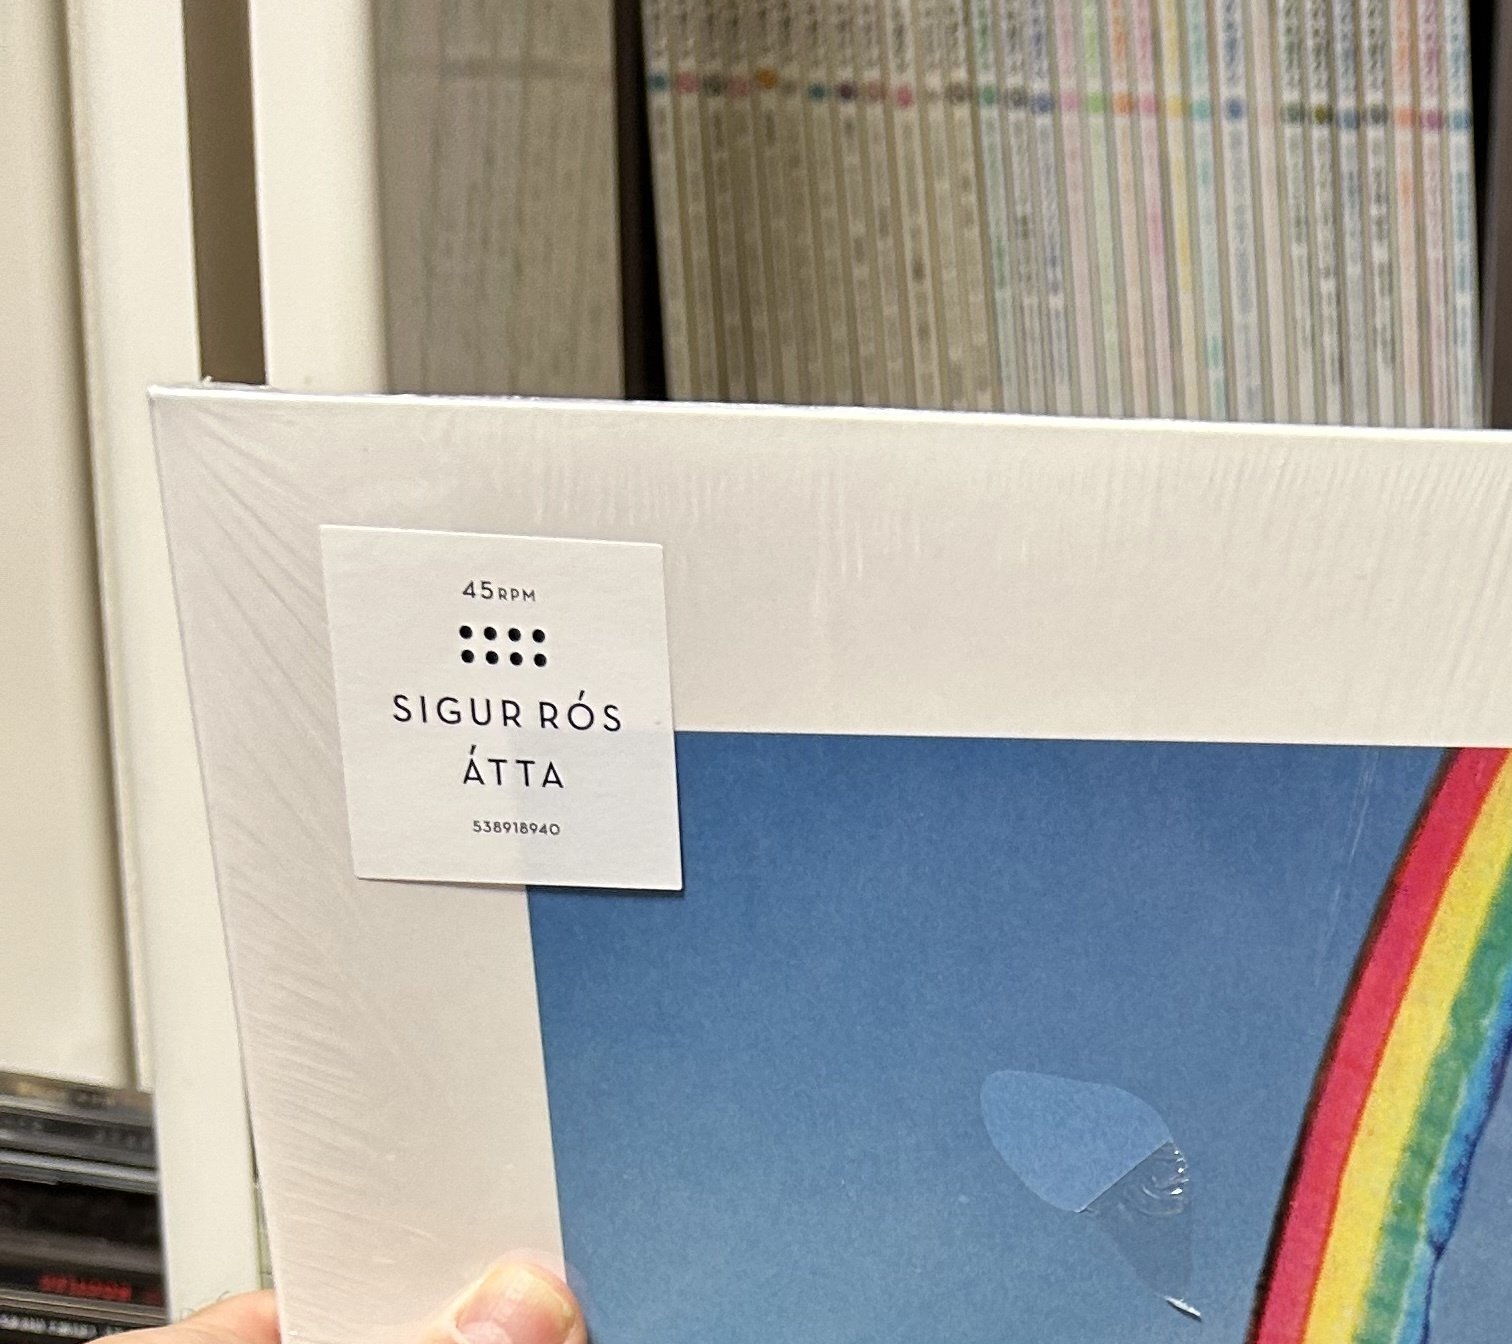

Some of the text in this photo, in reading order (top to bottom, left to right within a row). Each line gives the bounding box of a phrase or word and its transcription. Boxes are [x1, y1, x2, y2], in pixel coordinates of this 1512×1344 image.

[393, 690, 622, 732] SIGUR RÓS
[463, 744, 565, 789] ÁTTA
[472, 820, 561, 838] 538918940
